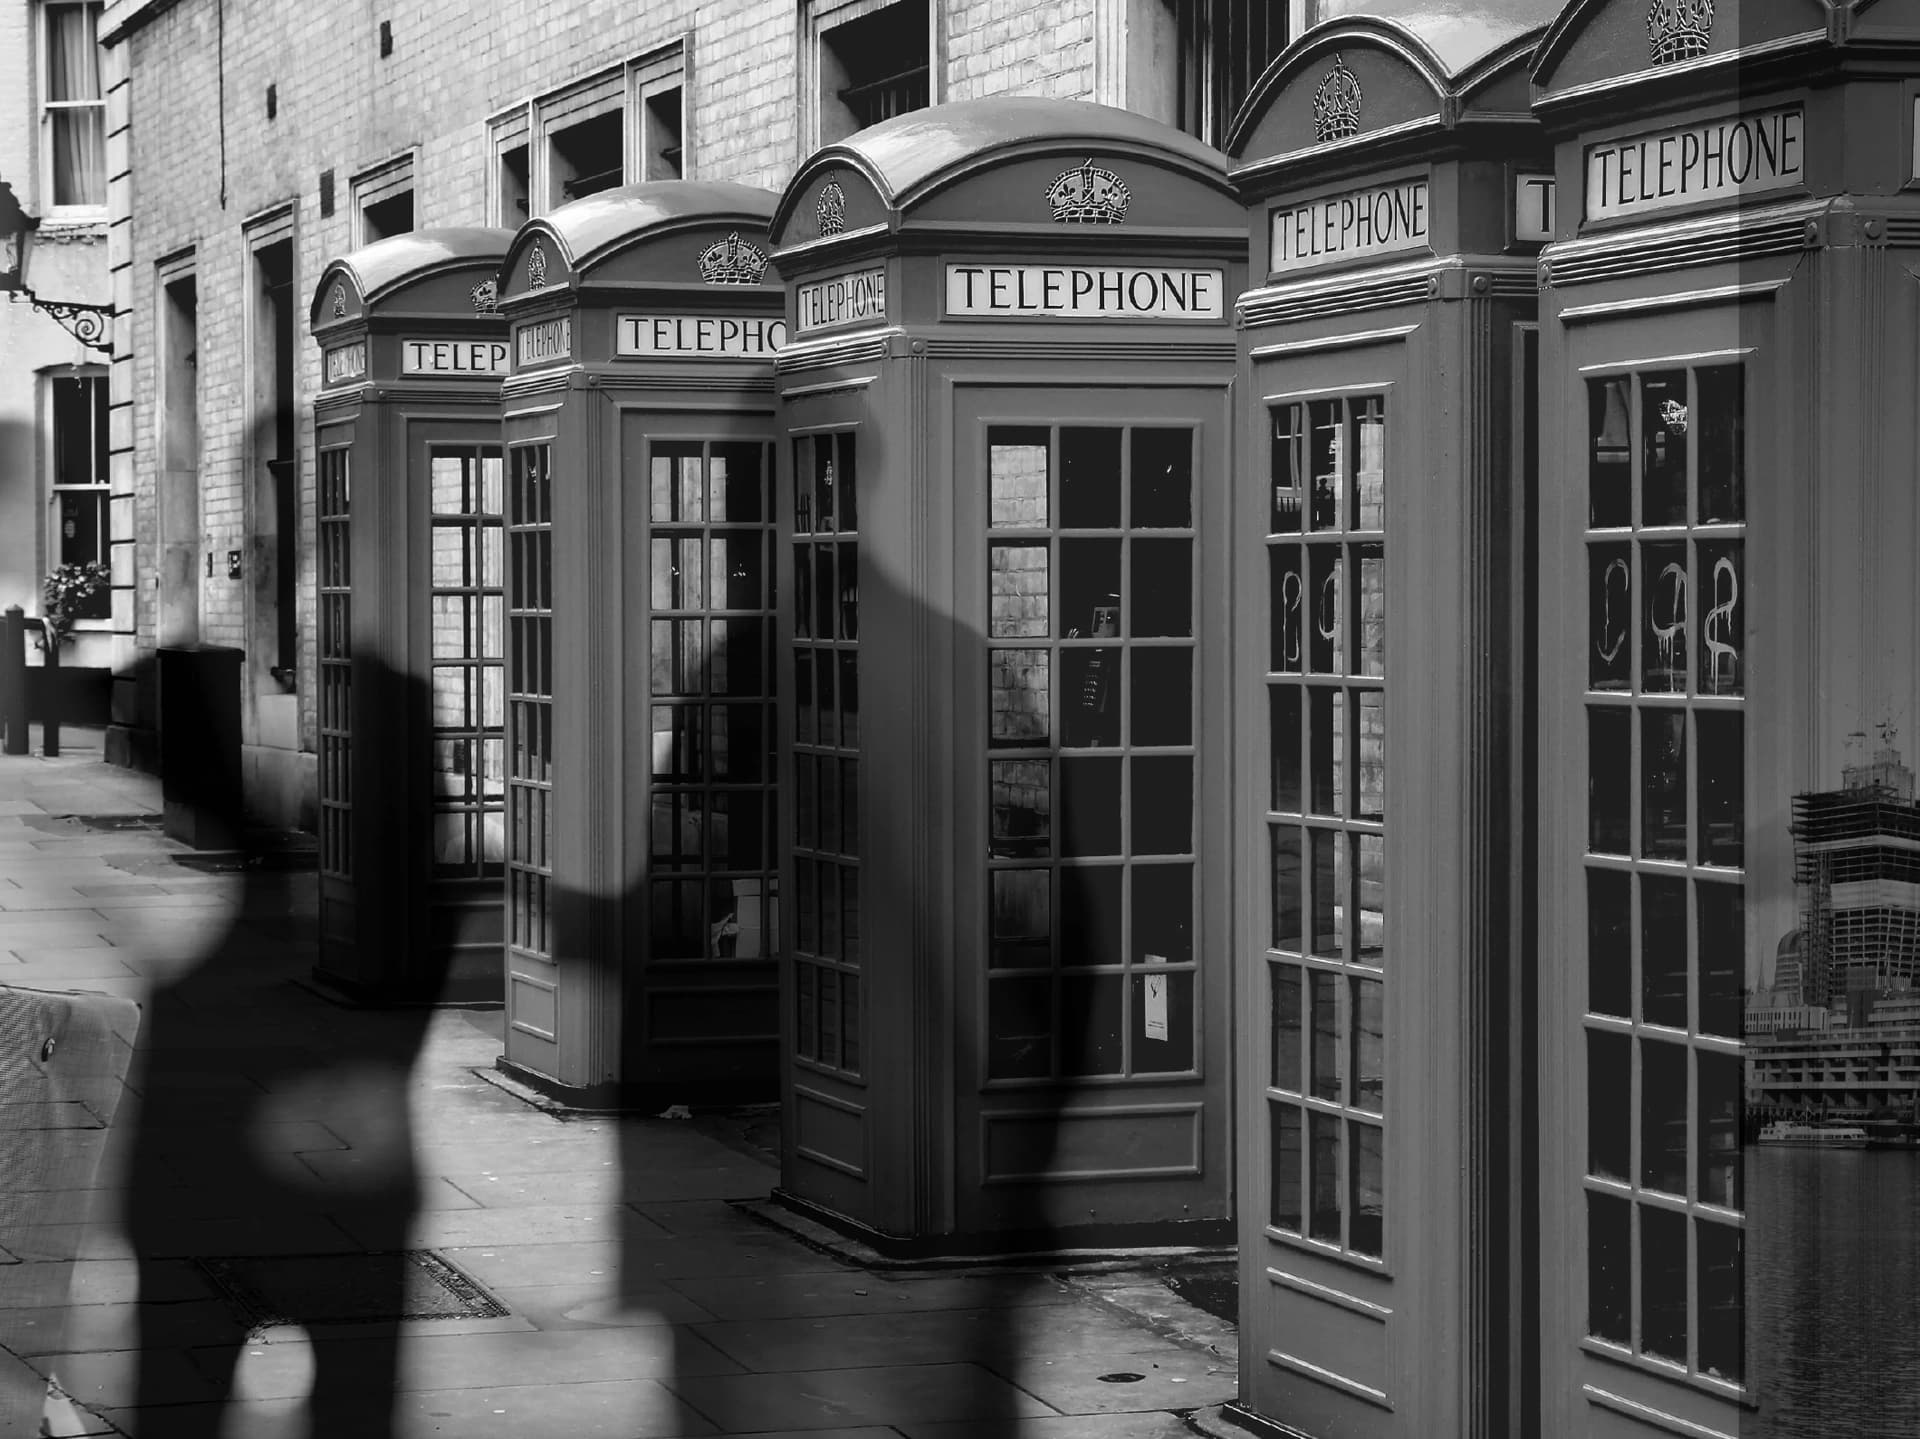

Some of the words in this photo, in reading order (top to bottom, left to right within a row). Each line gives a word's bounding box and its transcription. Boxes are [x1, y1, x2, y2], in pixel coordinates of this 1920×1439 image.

[1594, 112, 1803, 207] TELEPHONE
[1278, 183, 1427, 261] TELEPHONE
[801, 272, 885, 327] TELEPHONE
[954, 267, 1213, 312] TELEPHONE
[409, 342, 508, 371] TELEP
[520, 319, 570, 360] TELEPHONE
